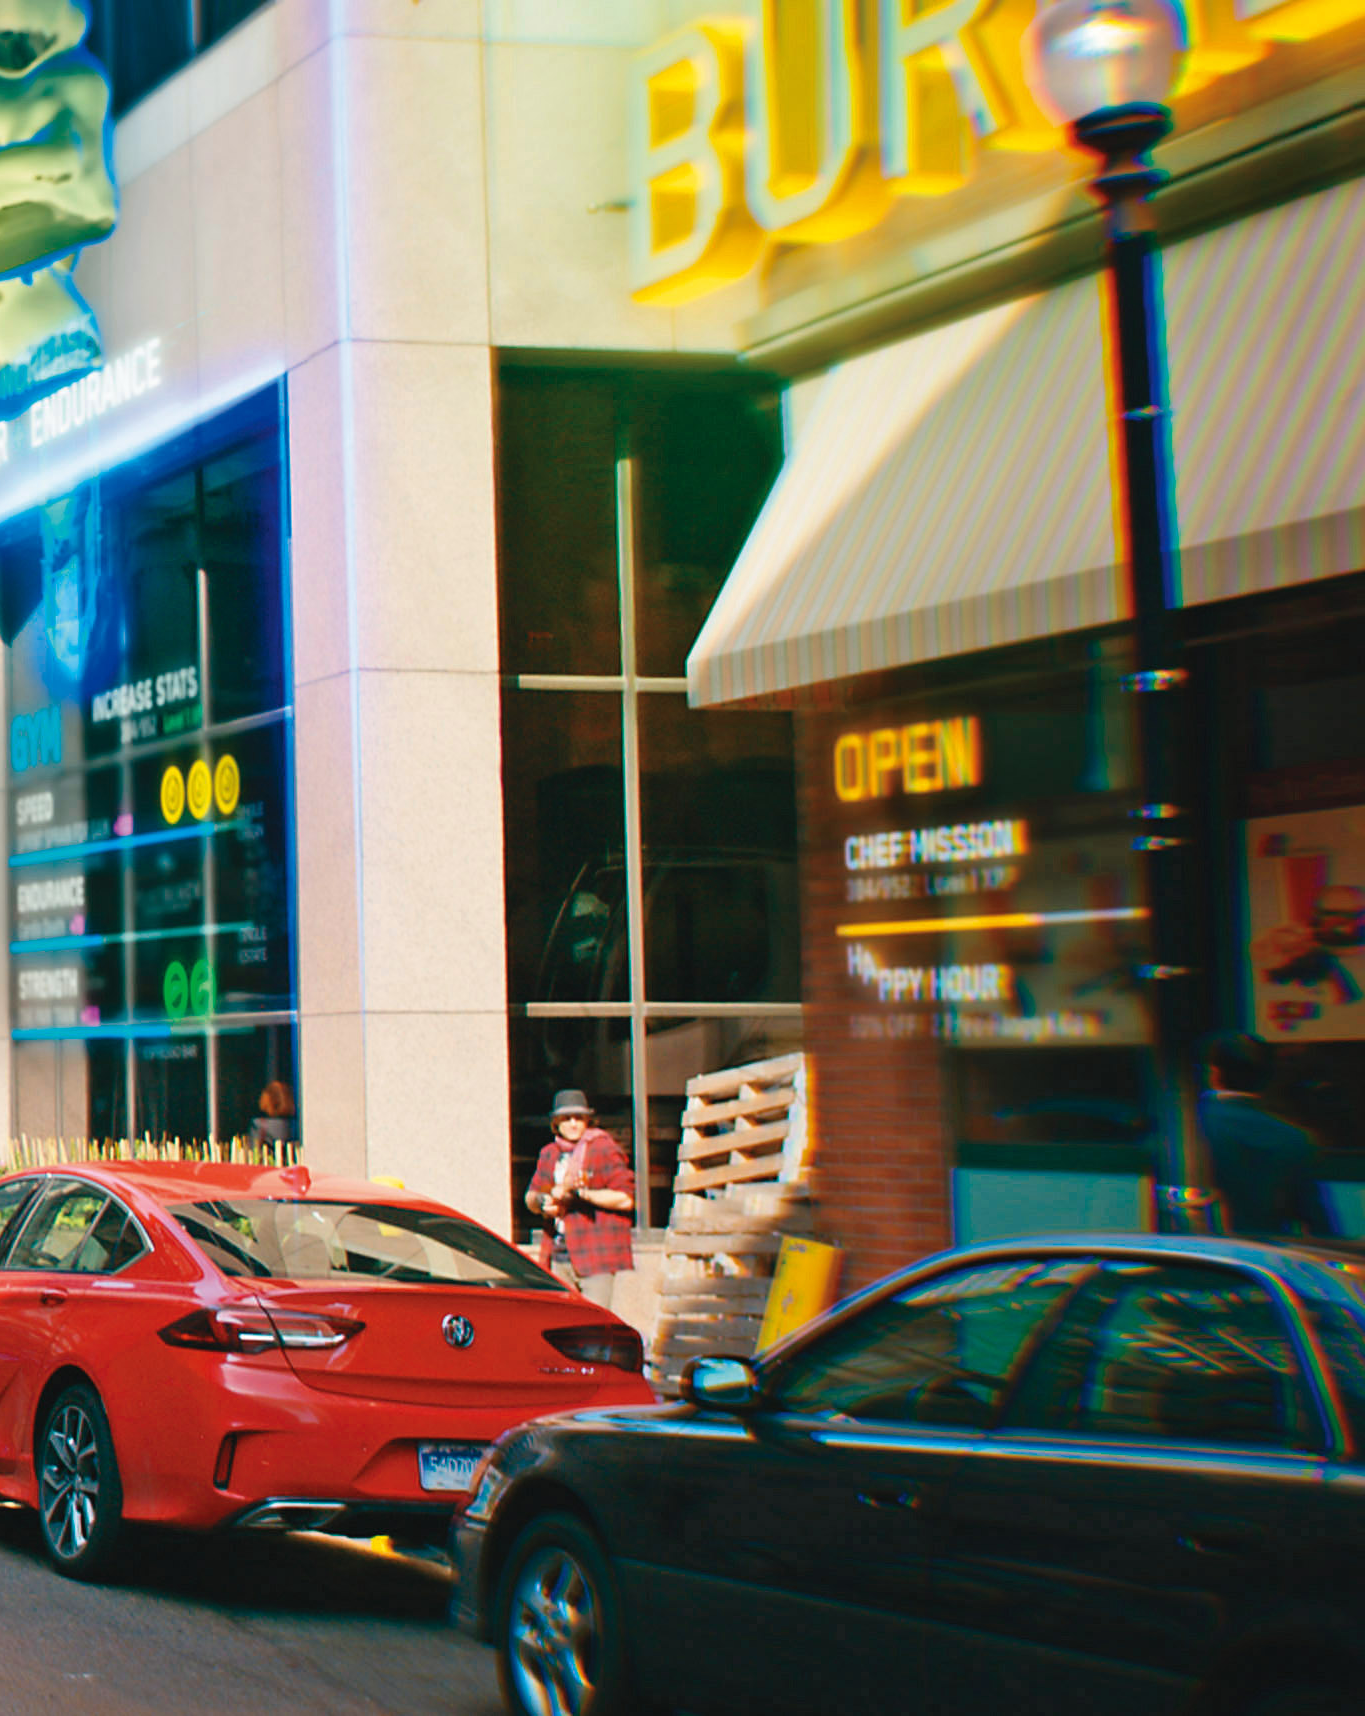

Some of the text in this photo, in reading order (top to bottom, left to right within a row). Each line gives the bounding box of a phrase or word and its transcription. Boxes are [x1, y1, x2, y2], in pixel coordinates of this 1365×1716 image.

[29, 336, 161, 448] ENDURANCE
[92, 679, 153, 723] INCREASE
[156, 666, 199, 707] STATS
[834, 717, 981, 802] OPEN
[845, 818, 1025, 871] CHEF MISSION
[17, 876, 86, 913] ENDURANCE
[930, 963, 1009, 1001] HOUR
